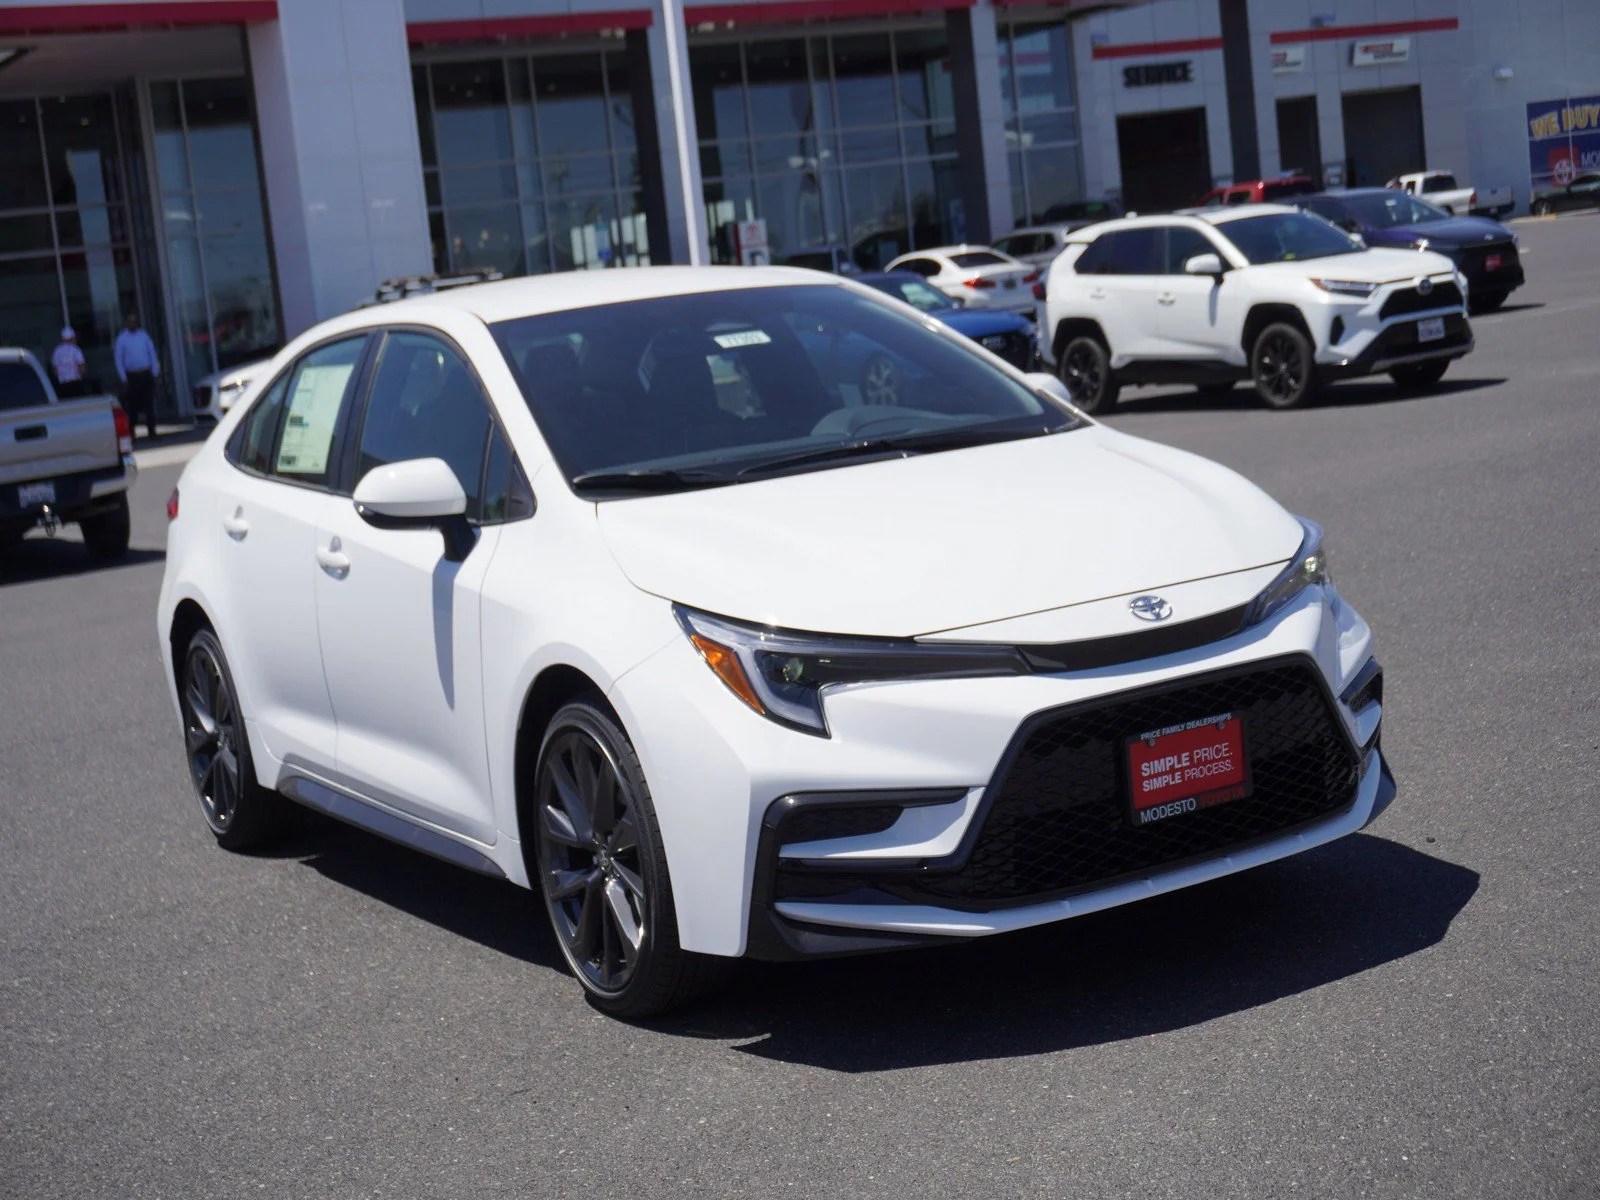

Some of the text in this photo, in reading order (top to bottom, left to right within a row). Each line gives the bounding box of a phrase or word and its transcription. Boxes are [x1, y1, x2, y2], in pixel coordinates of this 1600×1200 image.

[1530, 104, 1599, 141] WE BUY
[1581, 149, 1600, 168] MO
[1140, 712, 1232, 741] PRICE FAMILY DEALERSHIPS
[1141, 742, 1233, 777] SIMPLE PRICE.
[1142, 760, 1234, 792] SIMPLE PROCESS.
[1140, 798, 1196, 823] MODESTO
